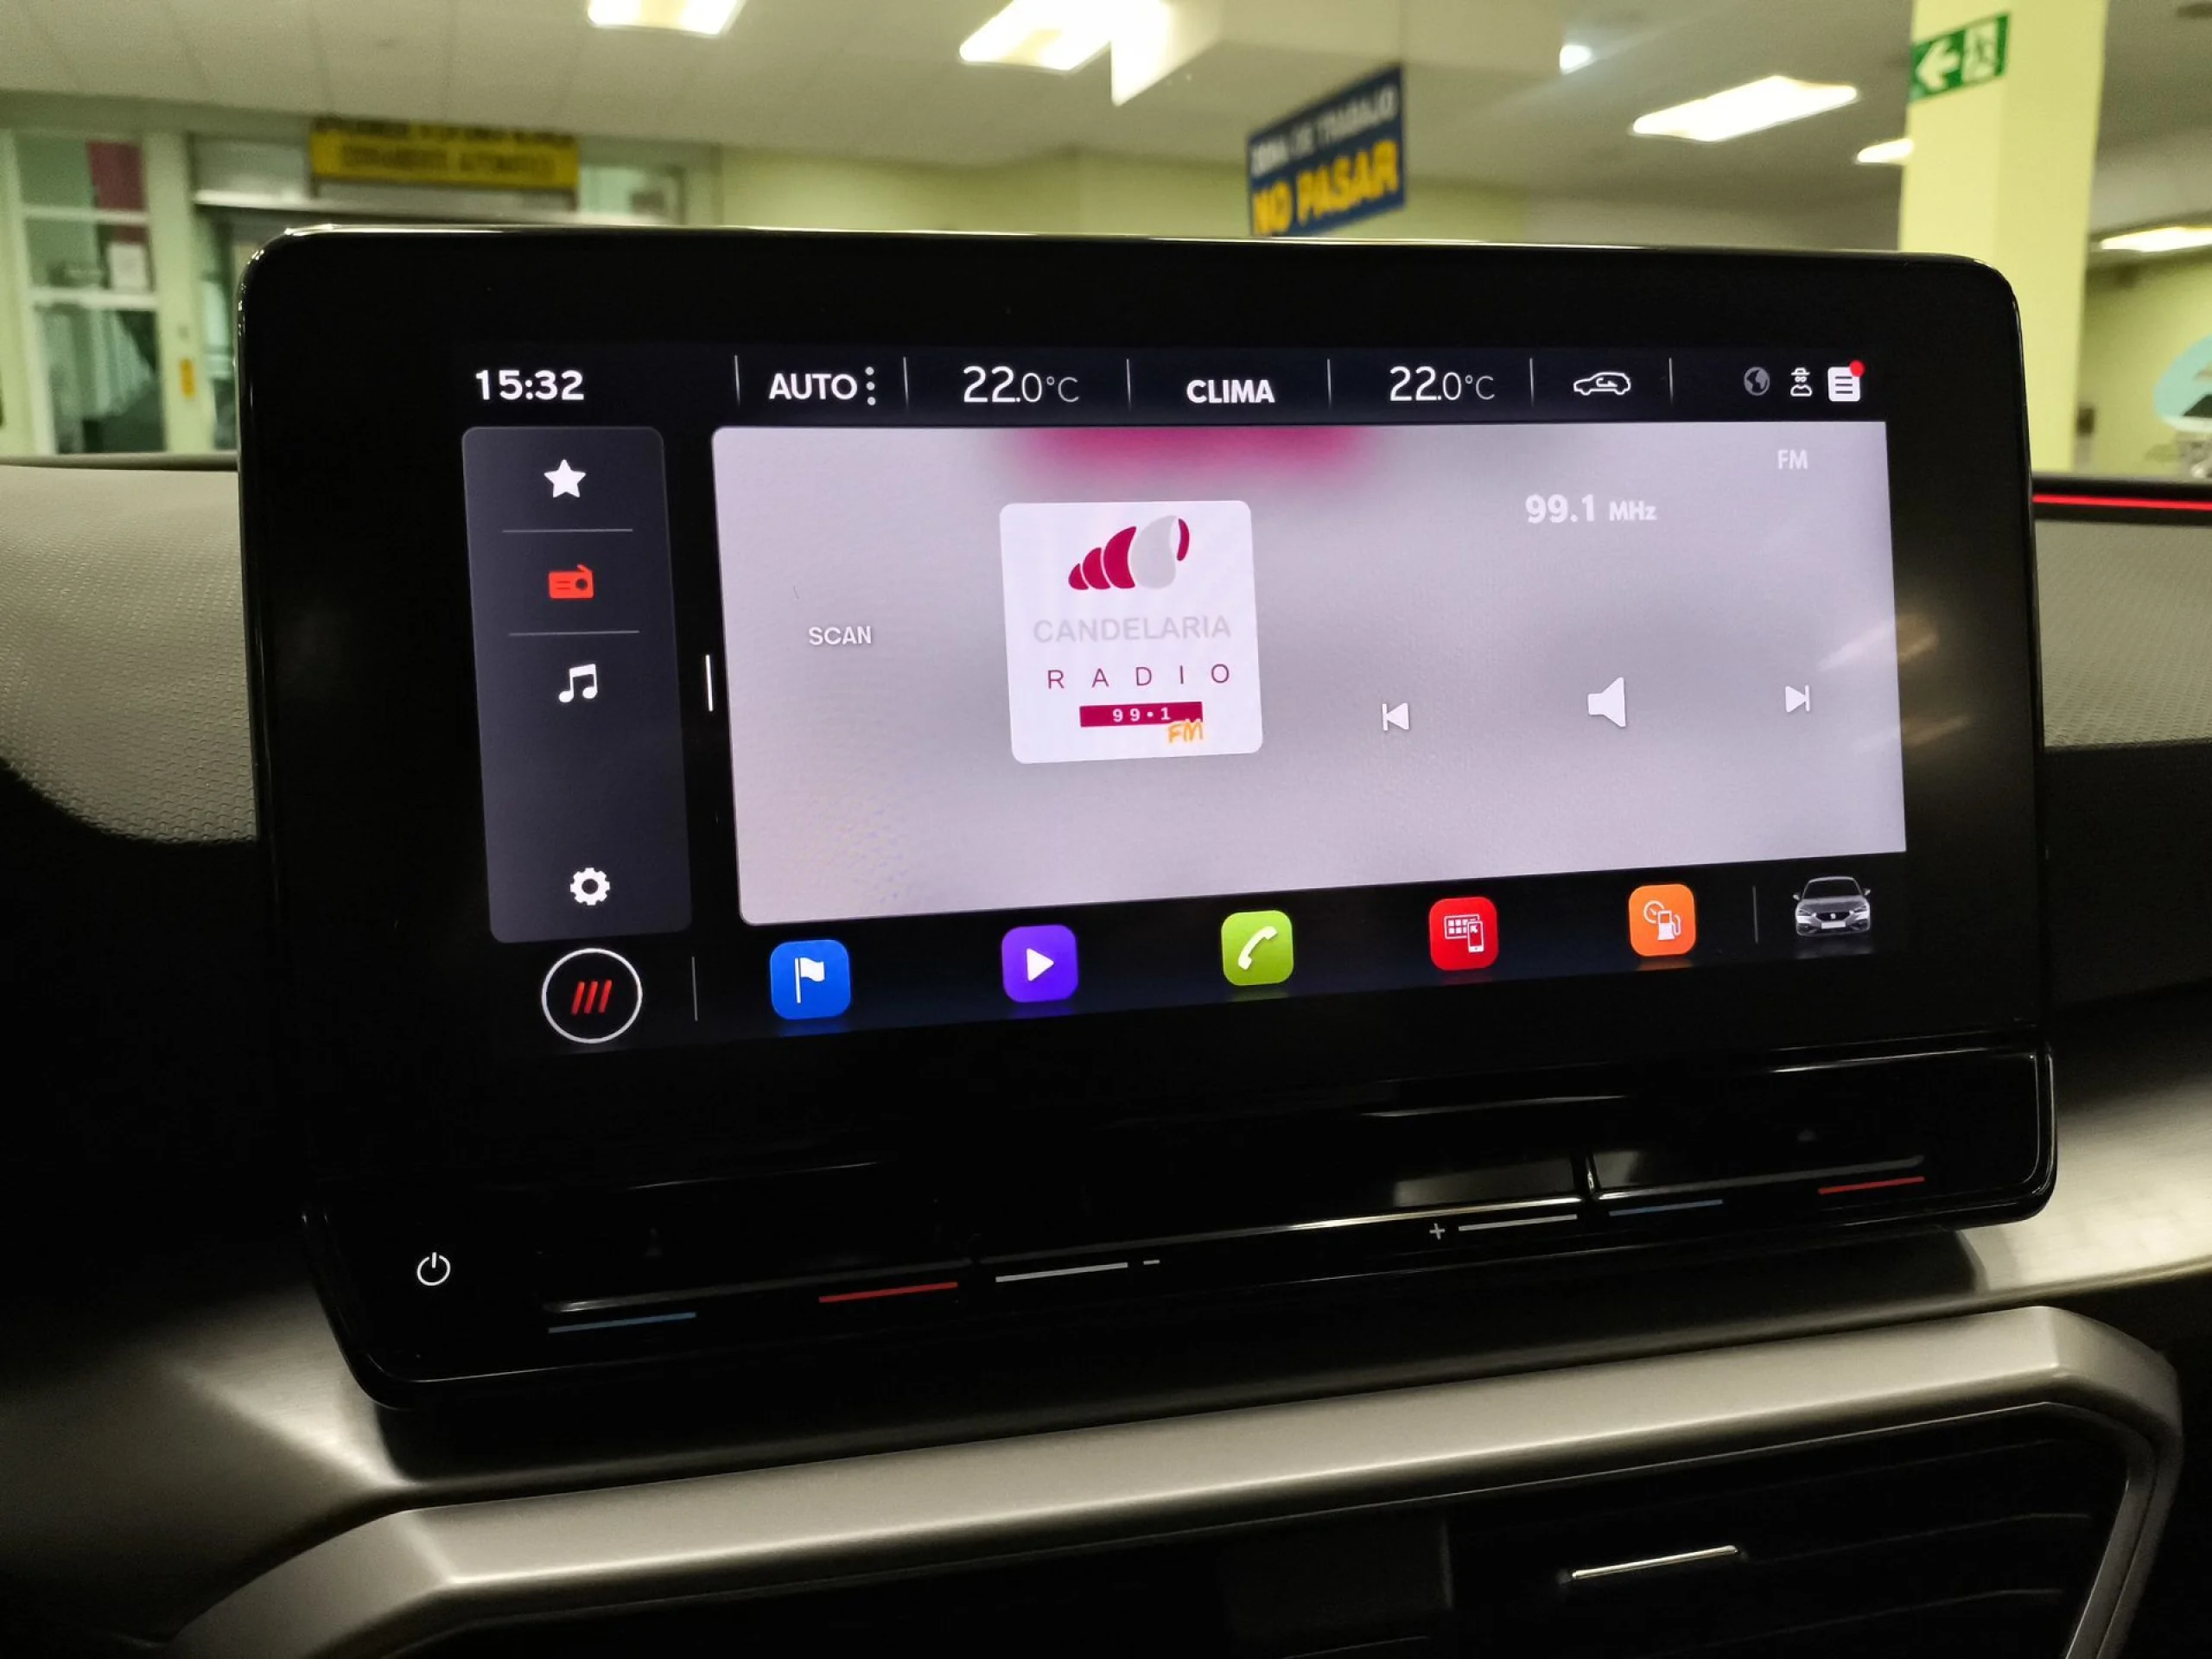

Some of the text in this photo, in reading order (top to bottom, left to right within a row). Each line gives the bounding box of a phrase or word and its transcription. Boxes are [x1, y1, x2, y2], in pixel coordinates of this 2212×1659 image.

[1254, 139, 1398, 236] NO PASAR
[475, 369, 585, 401] 15:32
[768, 372, 858, 400] AUTO
[1185, 378, 1275, 404] CLIMA
[1777, 448, 1808, 470] FM
[1524, 493, 1658, 524] 99.1 MHz
[808, 625, 872, 646] SCAN
[1033, 615, 1231, 643] CANDELARIA
[1047, 664, 1230, 689] RADIO
[1167, 718, 1204, 744] FM
